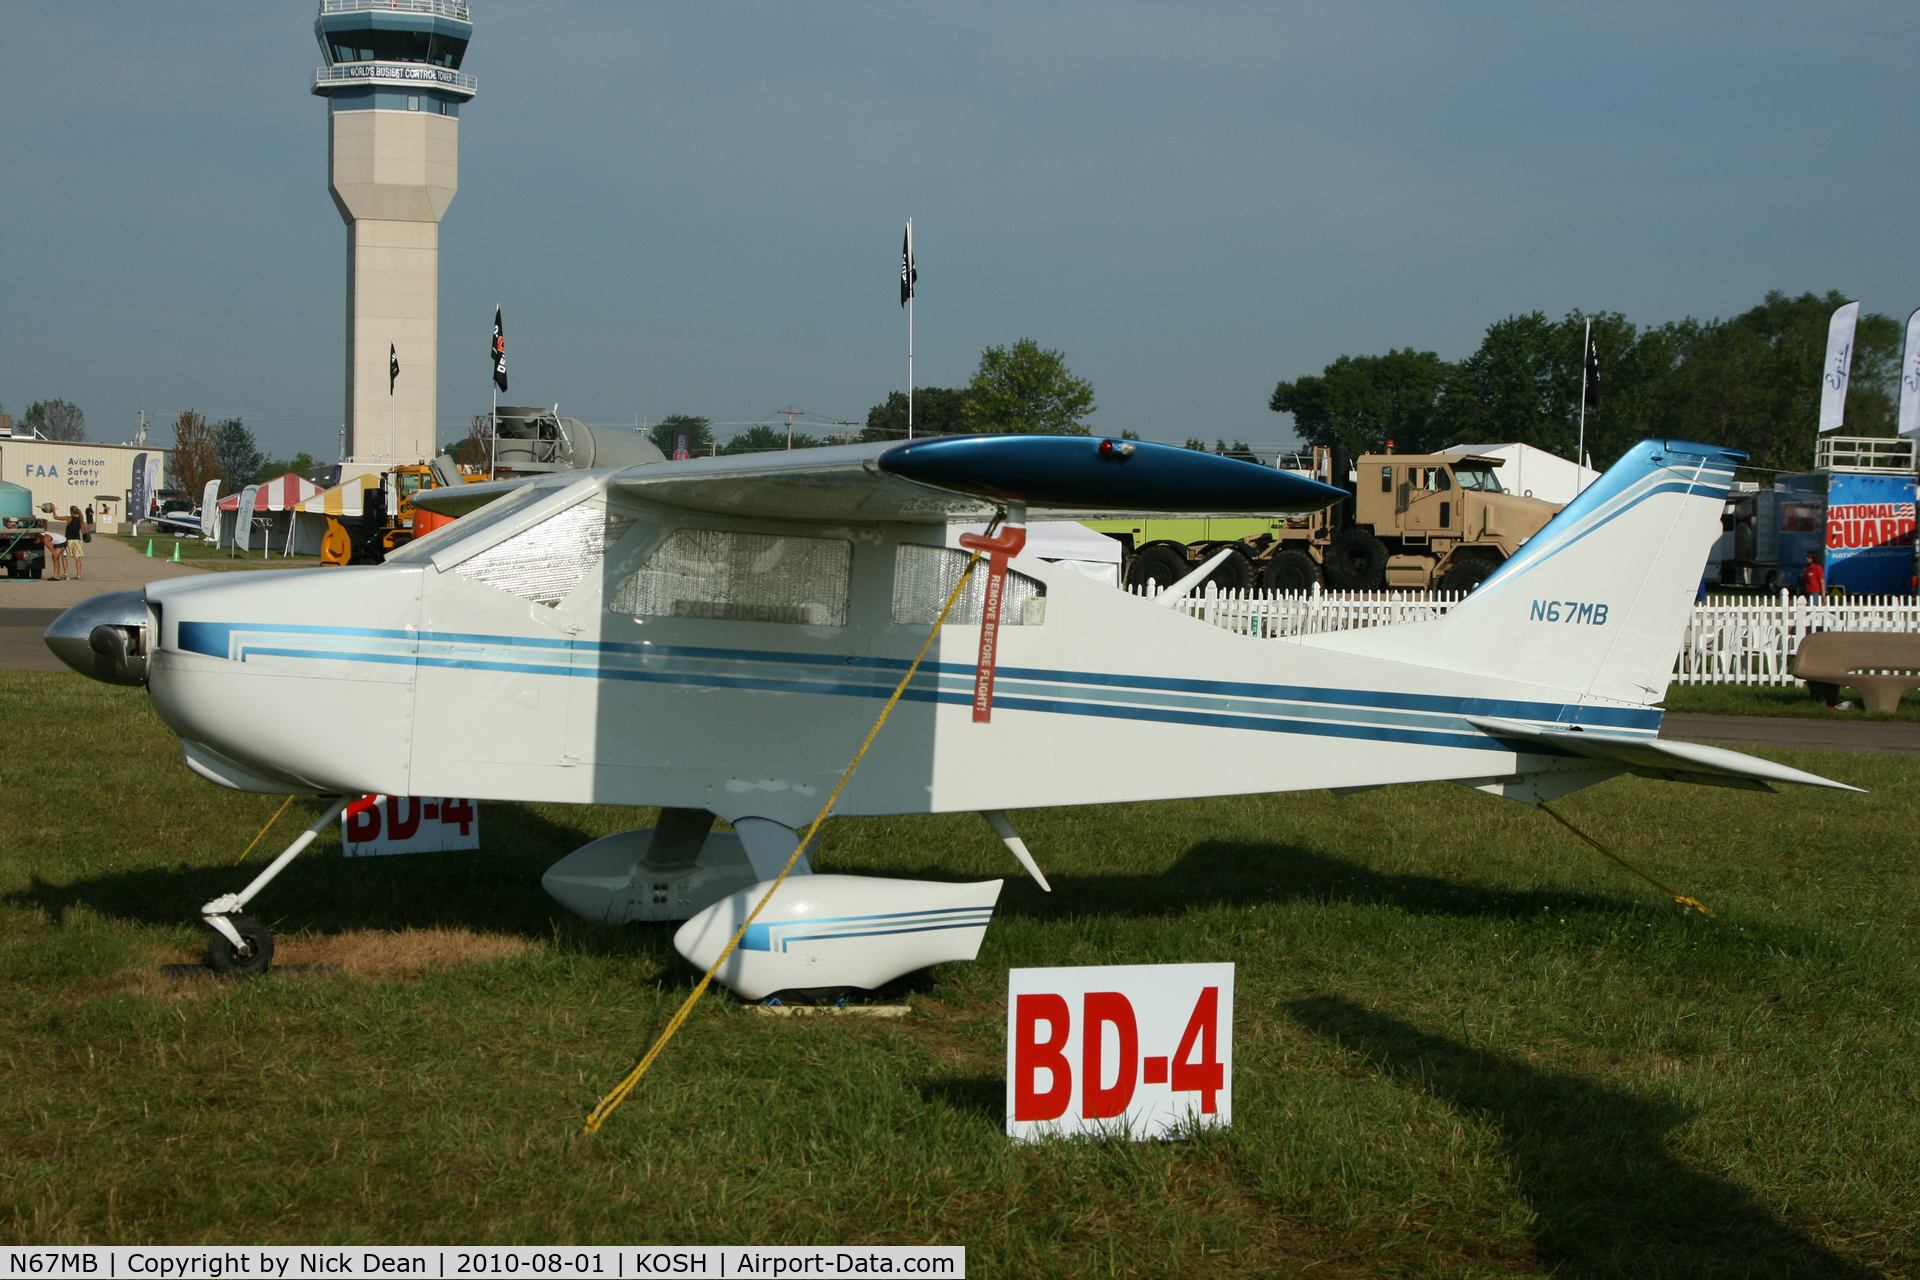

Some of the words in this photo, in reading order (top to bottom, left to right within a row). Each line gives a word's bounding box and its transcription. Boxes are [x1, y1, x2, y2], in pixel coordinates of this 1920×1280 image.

[350, 66, 374, 77] WORLD'S
[376, 67, 404, 78] BUSIEST
[405, 68, 437, 80] CONTROL
[437, 71, 452, 82] TOWER
[26, 464, 59, 478] FAA
[67, 467, 99, 478] Safety
[68, 458, 105, 466] Aviation
[67, 477, 99, 486] Center
[240, 500, 251, 532] InnovAero
[1827, 504, 1895, 520] NATIONAL
[1826, 519, 1916, 549] GUARD
[986, 574, 1001, 620] REMOVE
[675, 600, 810, 624] EXPERIMENTAL
[1530, 599, 1609, 626] N67MB
[981, 623, 995, 667] BEFORE
[976, 669, 990, 711] FLIGHT!
[1015, 986, 1224, 1122] BD-4
